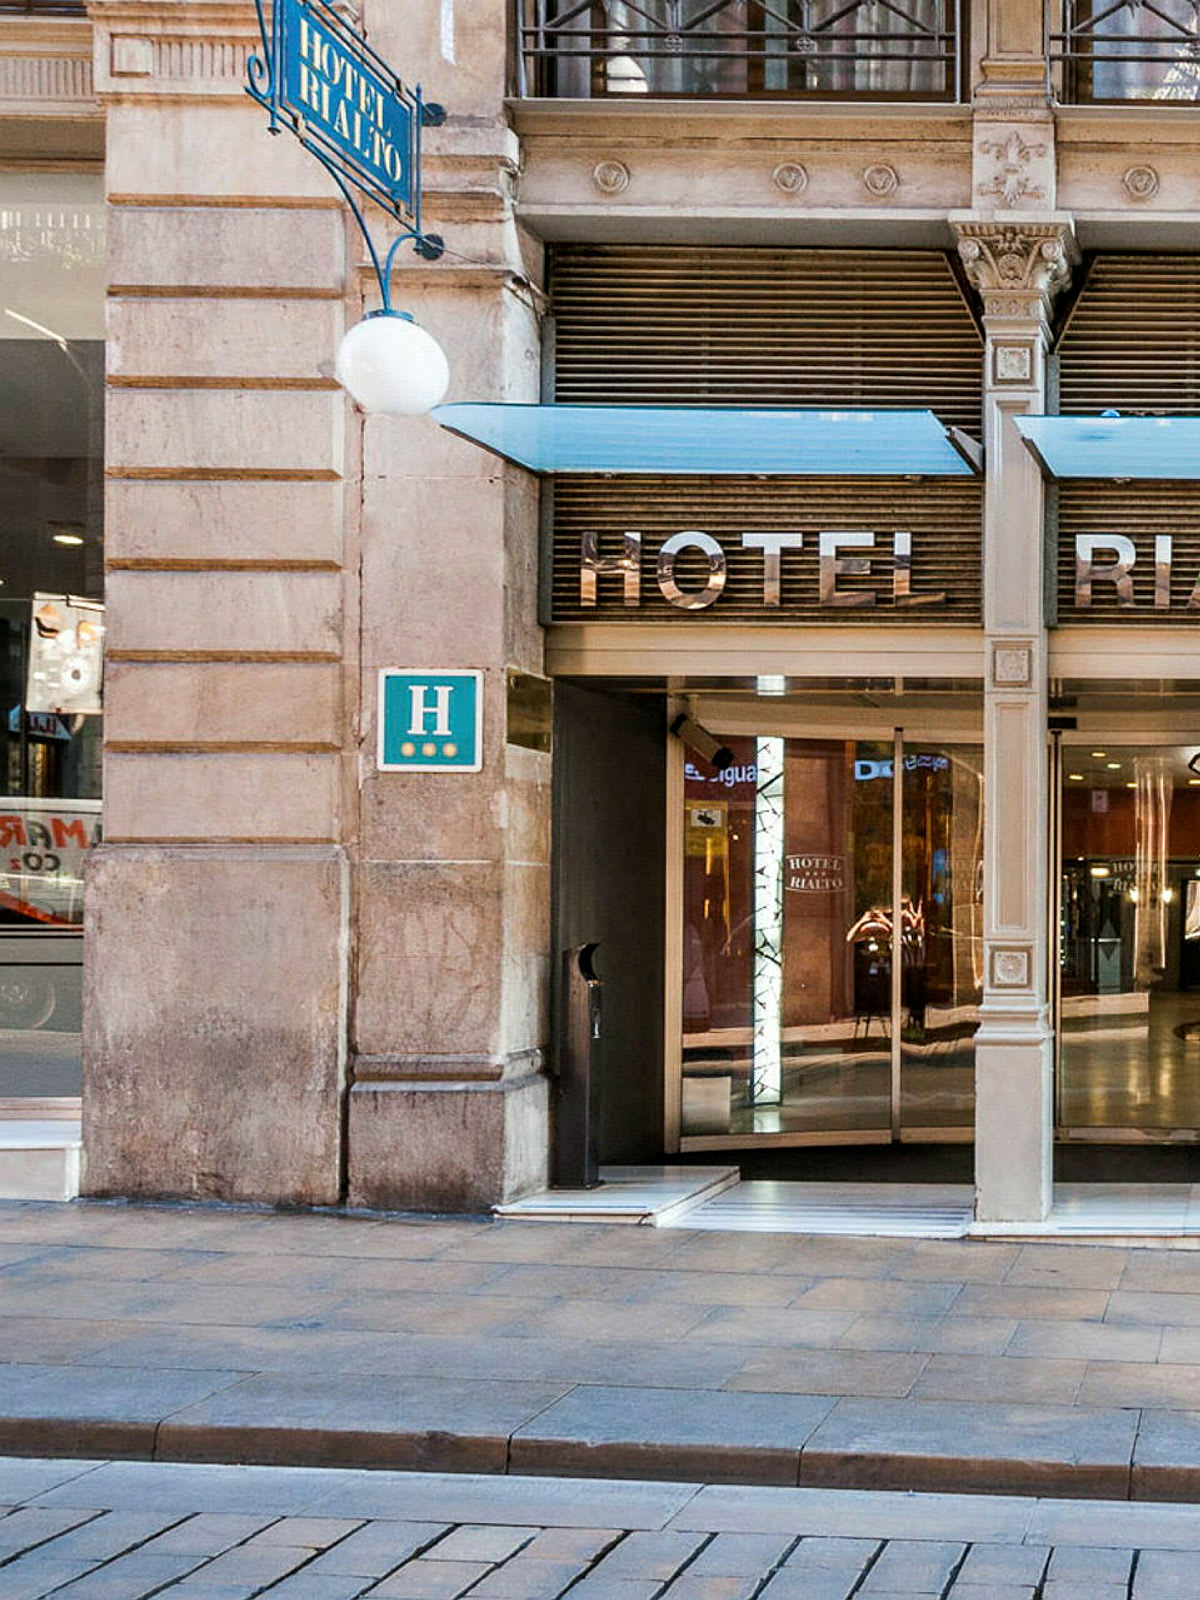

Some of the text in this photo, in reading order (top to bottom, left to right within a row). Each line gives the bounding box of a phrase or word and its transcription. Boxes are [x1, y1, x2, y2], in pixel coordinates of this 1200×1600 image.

[300, 18, 392, 139] HOTEL
[300, 61, 402, 183] RIALTO
[579, 531, 947, 610] HOTEL
[407, 684, 455, 736] H
[789, 858, 842, 871] HOTEL
[789, 876, 844, 890] RIALTO
